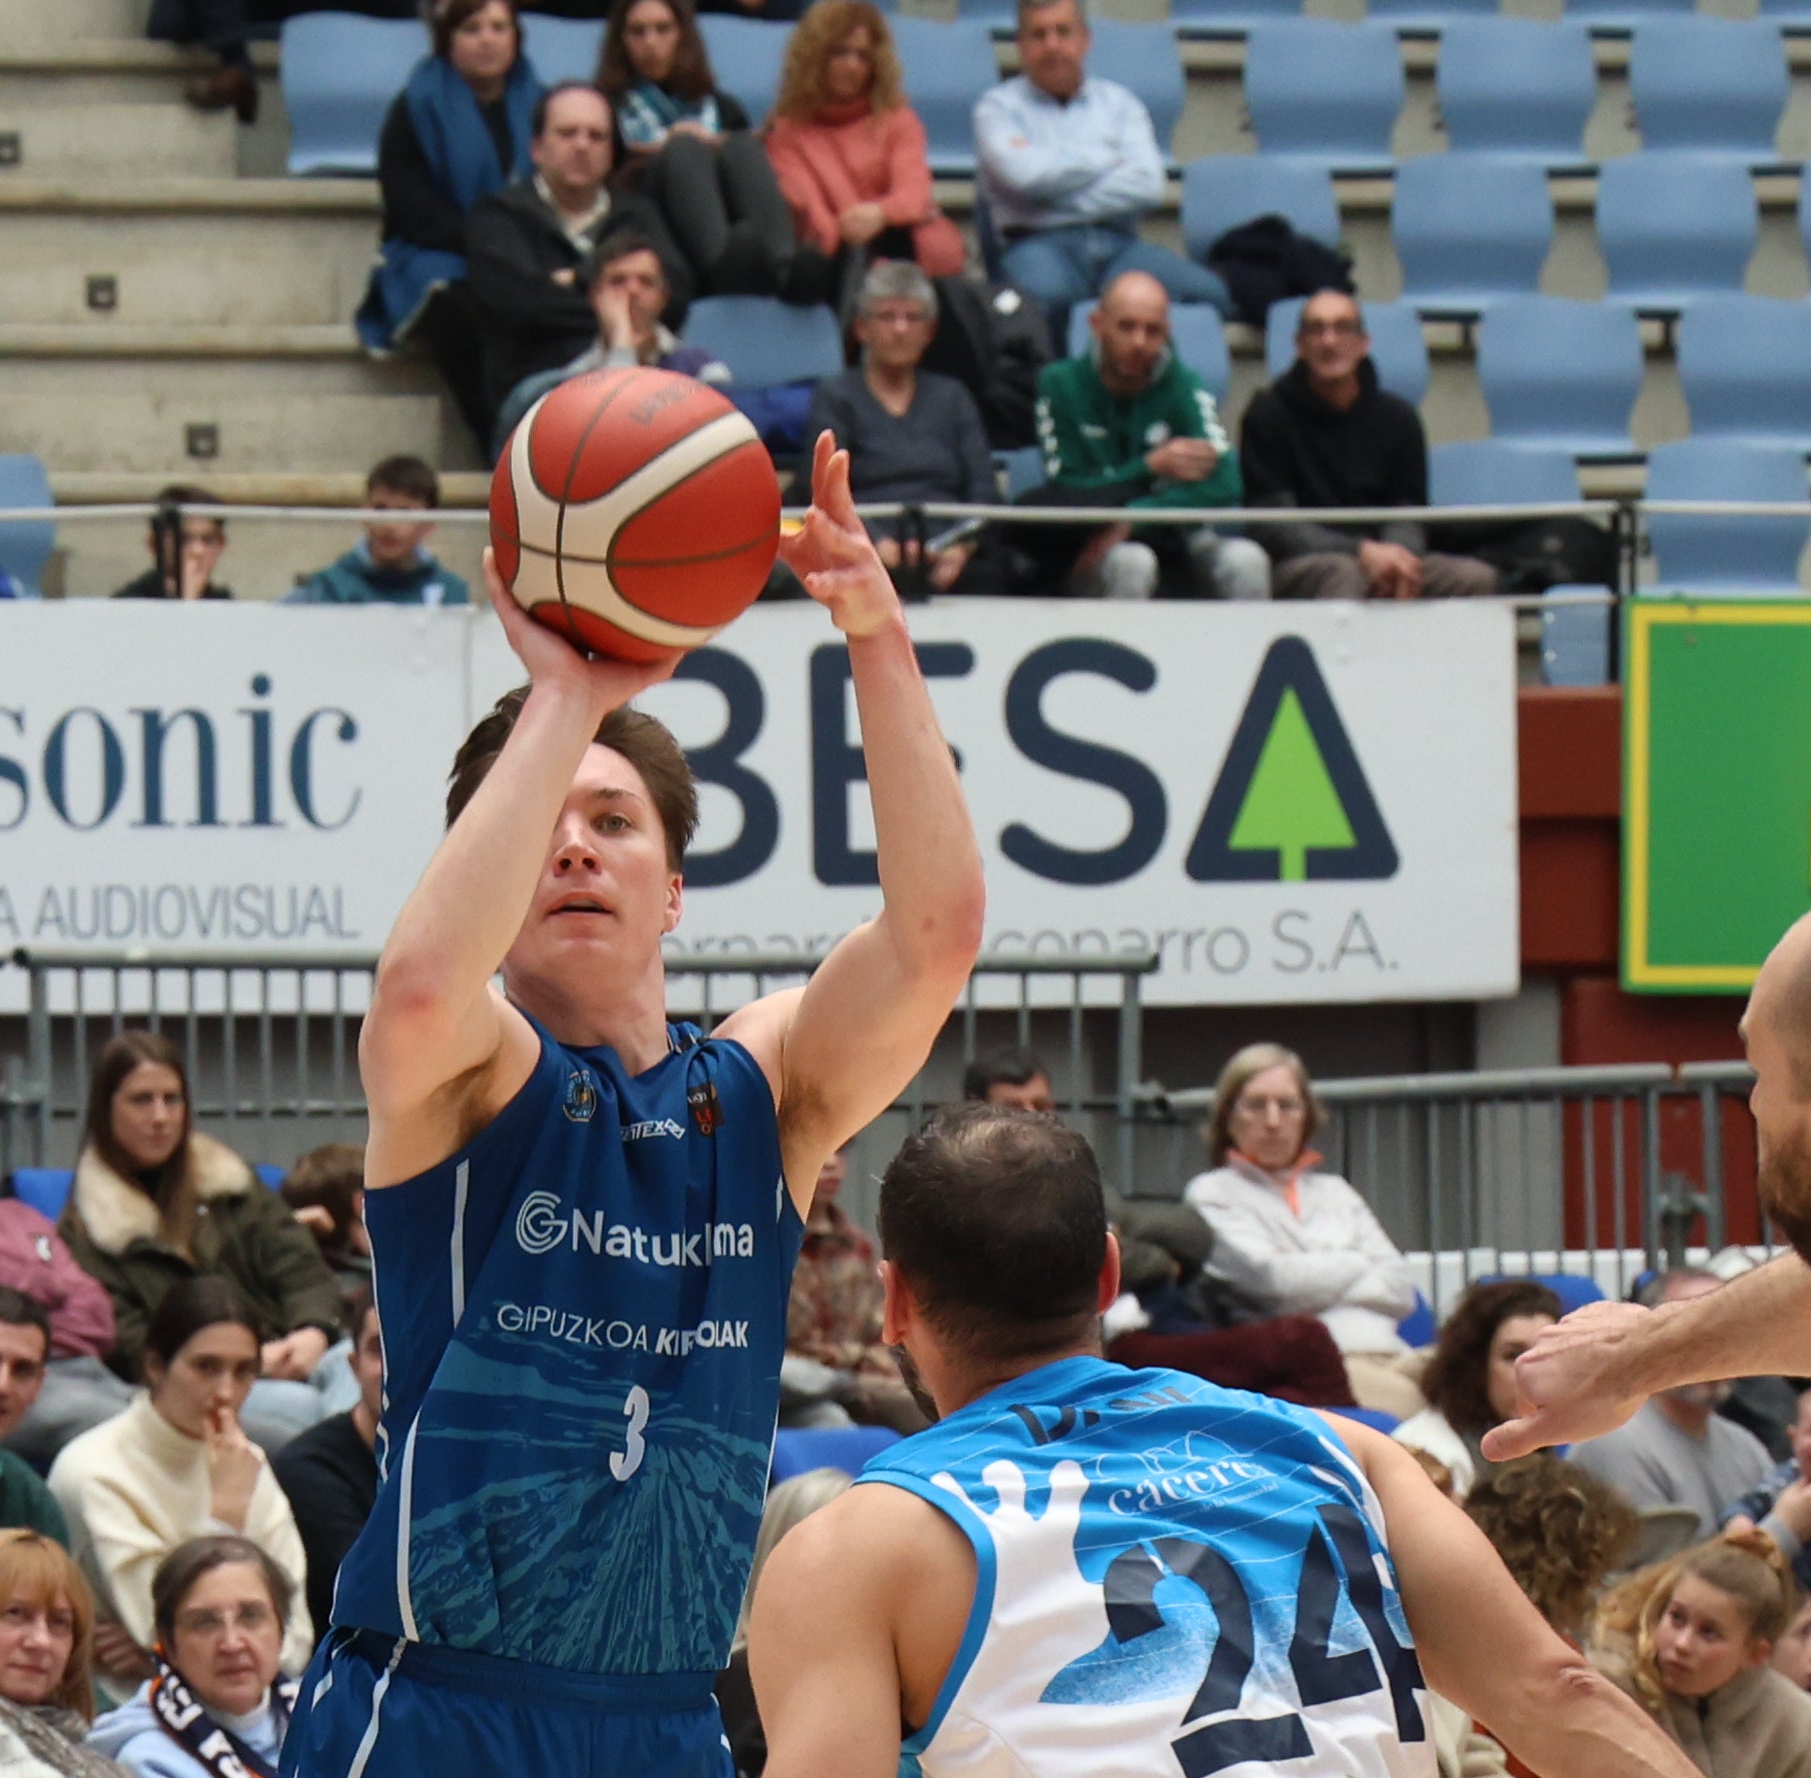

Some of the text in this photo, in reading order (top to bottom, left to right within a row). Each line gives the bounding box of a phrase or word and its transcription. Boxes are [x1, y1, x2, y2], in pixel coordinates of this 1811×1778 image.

[36, 882, 362, 941] AUDIOVISUAL
[1272, 908, 1399, 975] S.A.
[497, 1304, 648, 1351] GIPUZKOA
[609, 1385, 650, 1482] 3
